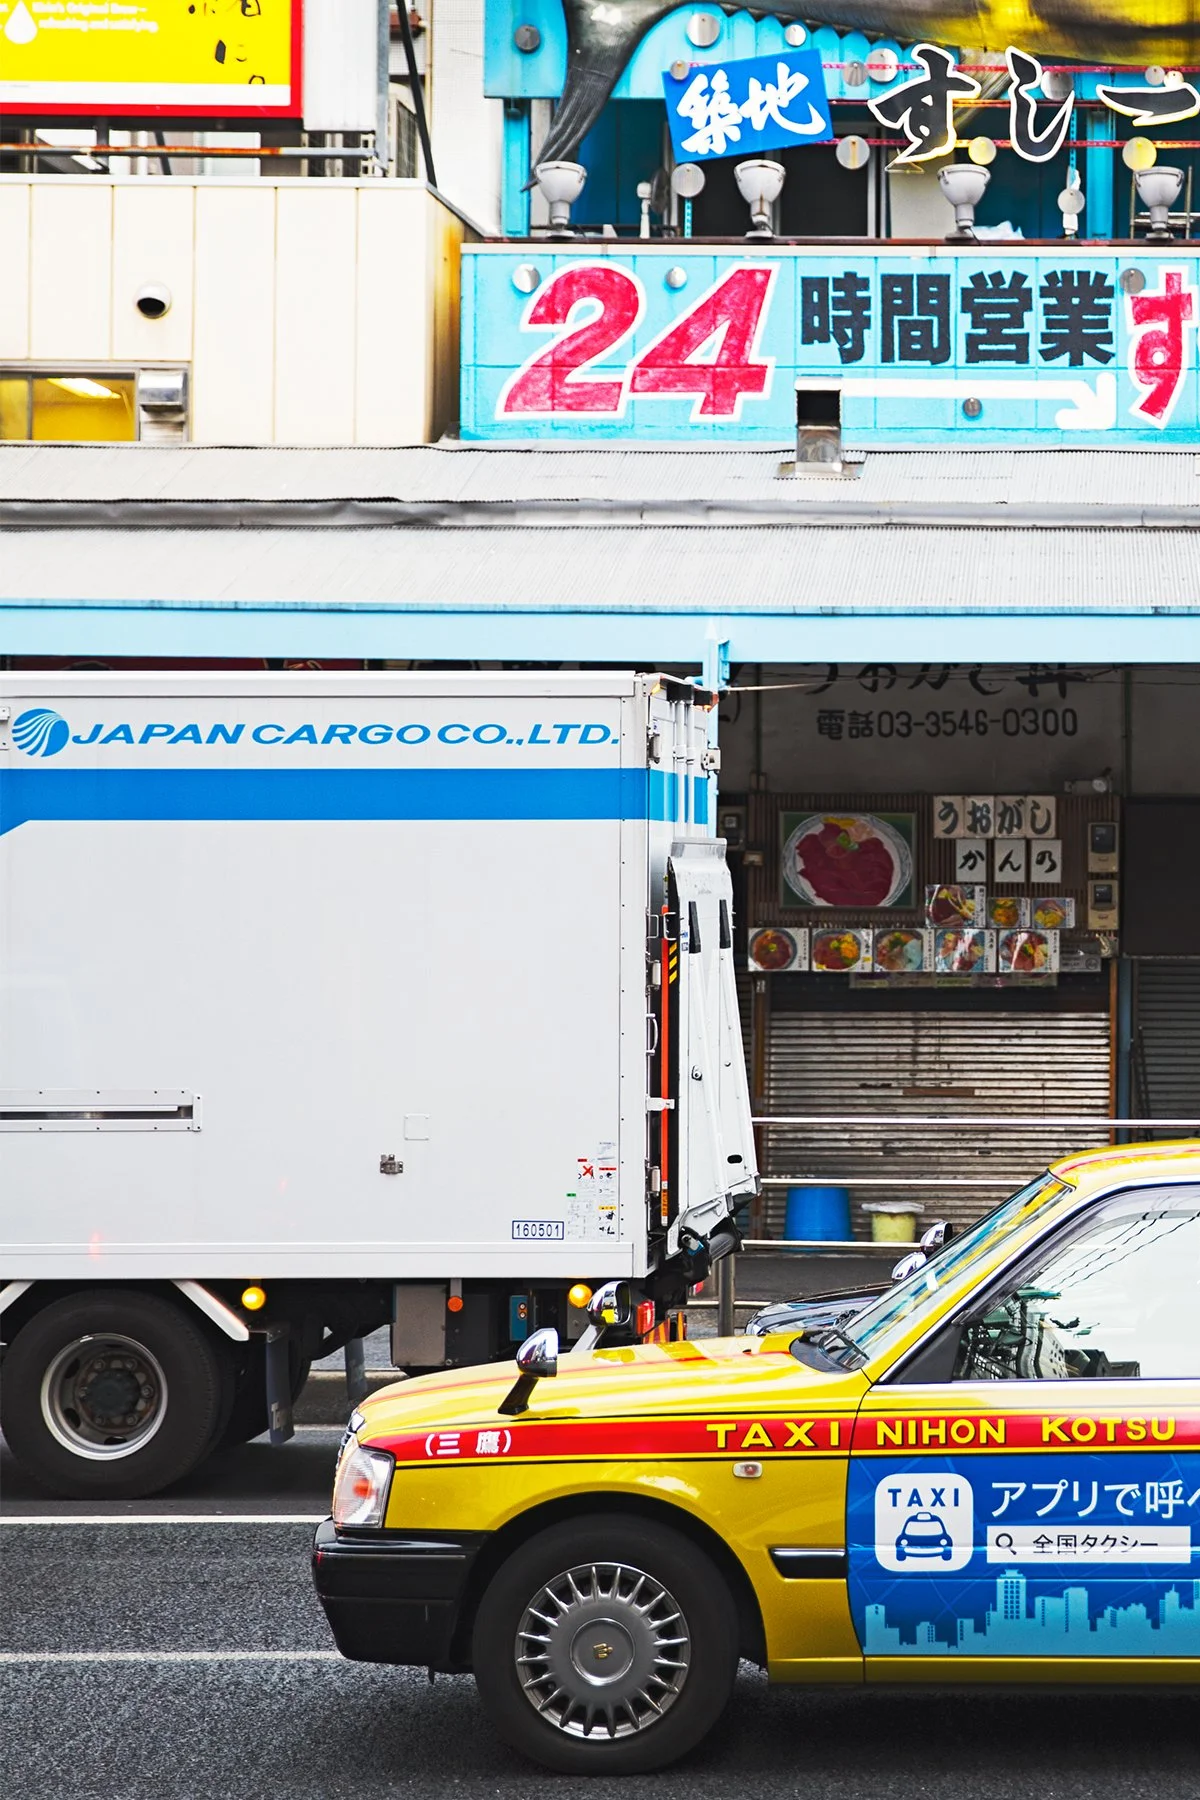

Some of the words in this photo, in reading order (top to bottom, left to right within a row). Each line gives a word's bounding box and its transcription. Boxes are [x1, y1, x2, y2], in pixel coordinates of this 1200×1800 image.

[674, 61, 828, 158] 築地
[72, 723, 246, 746] JAPAN
[515, 1223, 562, 1238] 160501
[706, 1421, 841, 1449] TAXI
[876, 1418, 1007, 1446] NIHON
[1041, 1416, 1176, 1443] KOTSU
[887, 1487, 960, 1507] TAXI
[1032, 1533, 1159, 1555] 全国タクシー
